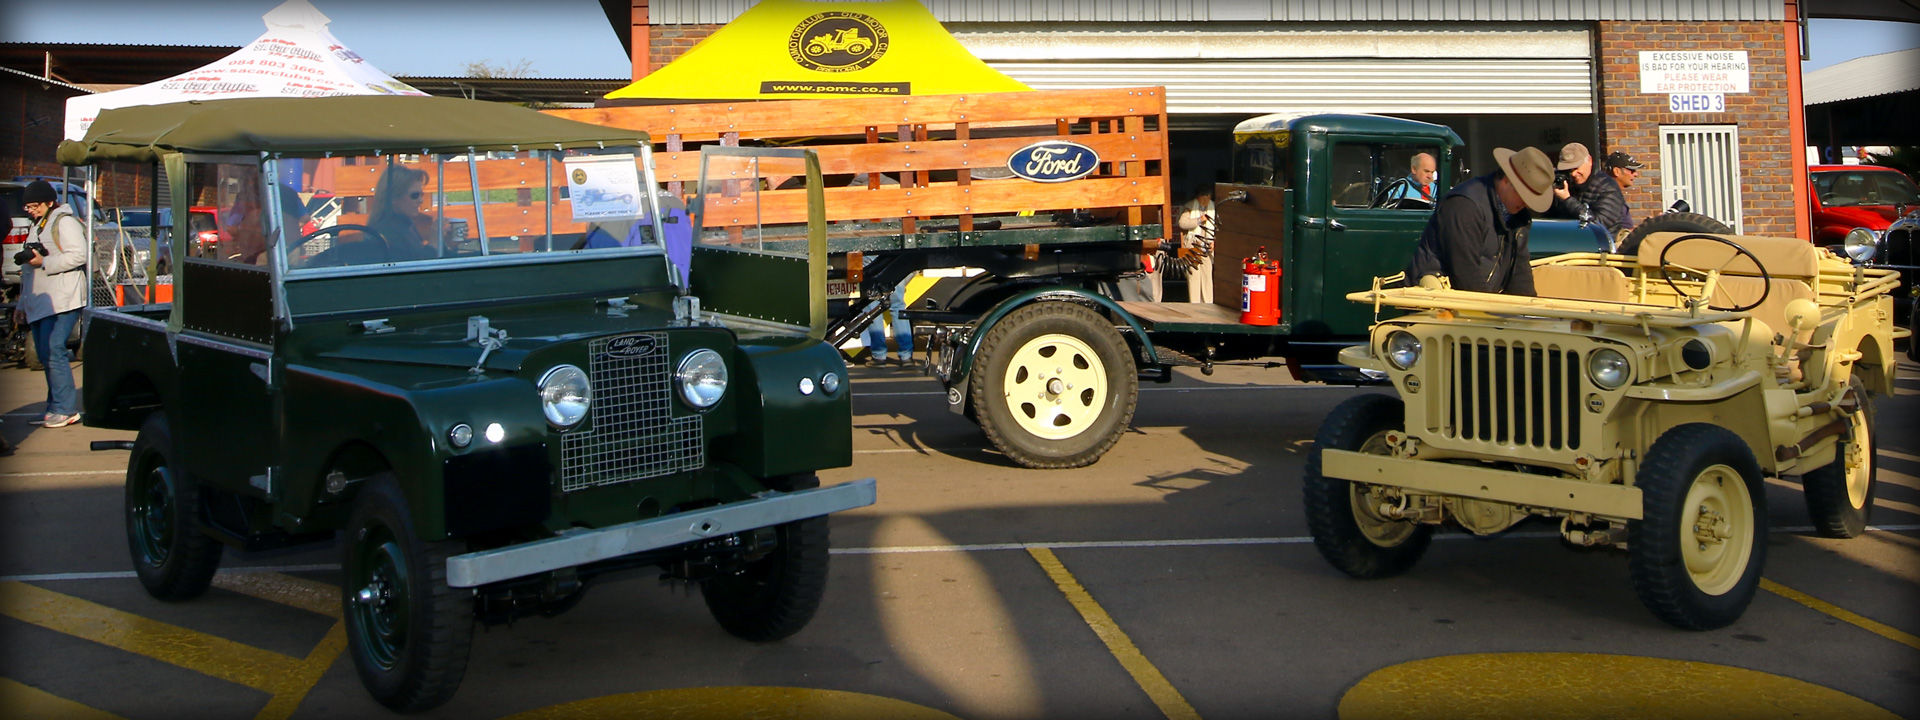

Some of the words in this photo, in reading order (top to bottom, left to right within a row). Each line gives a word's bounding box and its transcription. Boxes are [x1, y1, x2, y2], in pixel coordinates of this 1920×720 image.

[865, 17, 888, 39] MOTOR
[789, 13, 825, 64] OUMOTORKLUB
[871, 42, 888, 60] CLUB
[1653, 53, 1703, 61] EXCESSIVE
[1706, 53, 1734, 61] NOISE
[259, 59, 286, 69] 803
[290, 63, 325, 76] 3665
[816, 65, 863, 73] PRETORIA
[1642, 63, 1650, 71] IS
[1652, 63, 1668, 71] BAD
[1670, 63, 1686, 71] FOR
[1688, 63, 1709, 71] YOUR
[1711, 63, 1746, 71] HEARING
[189, 68, 355, 88] www.sacarclubs.co.za
[1664, 73, 1699, 81] PLEASE
[1702, 73, 1728, 81] WEAR
[772, 84, 899, 93] www.pomc.co.za
[1657, 83, 1675, 91] EAR
[1678, 83, 1737, 91] PROTECTION
[1671, 95, 1710, 111] SHED
[1715, 95, 1723, 111] 3
[1026, 146, 1082, 176] Ford
[614, 338, 635, 347] LAND
[624, 346, 650, 355] ROVER
